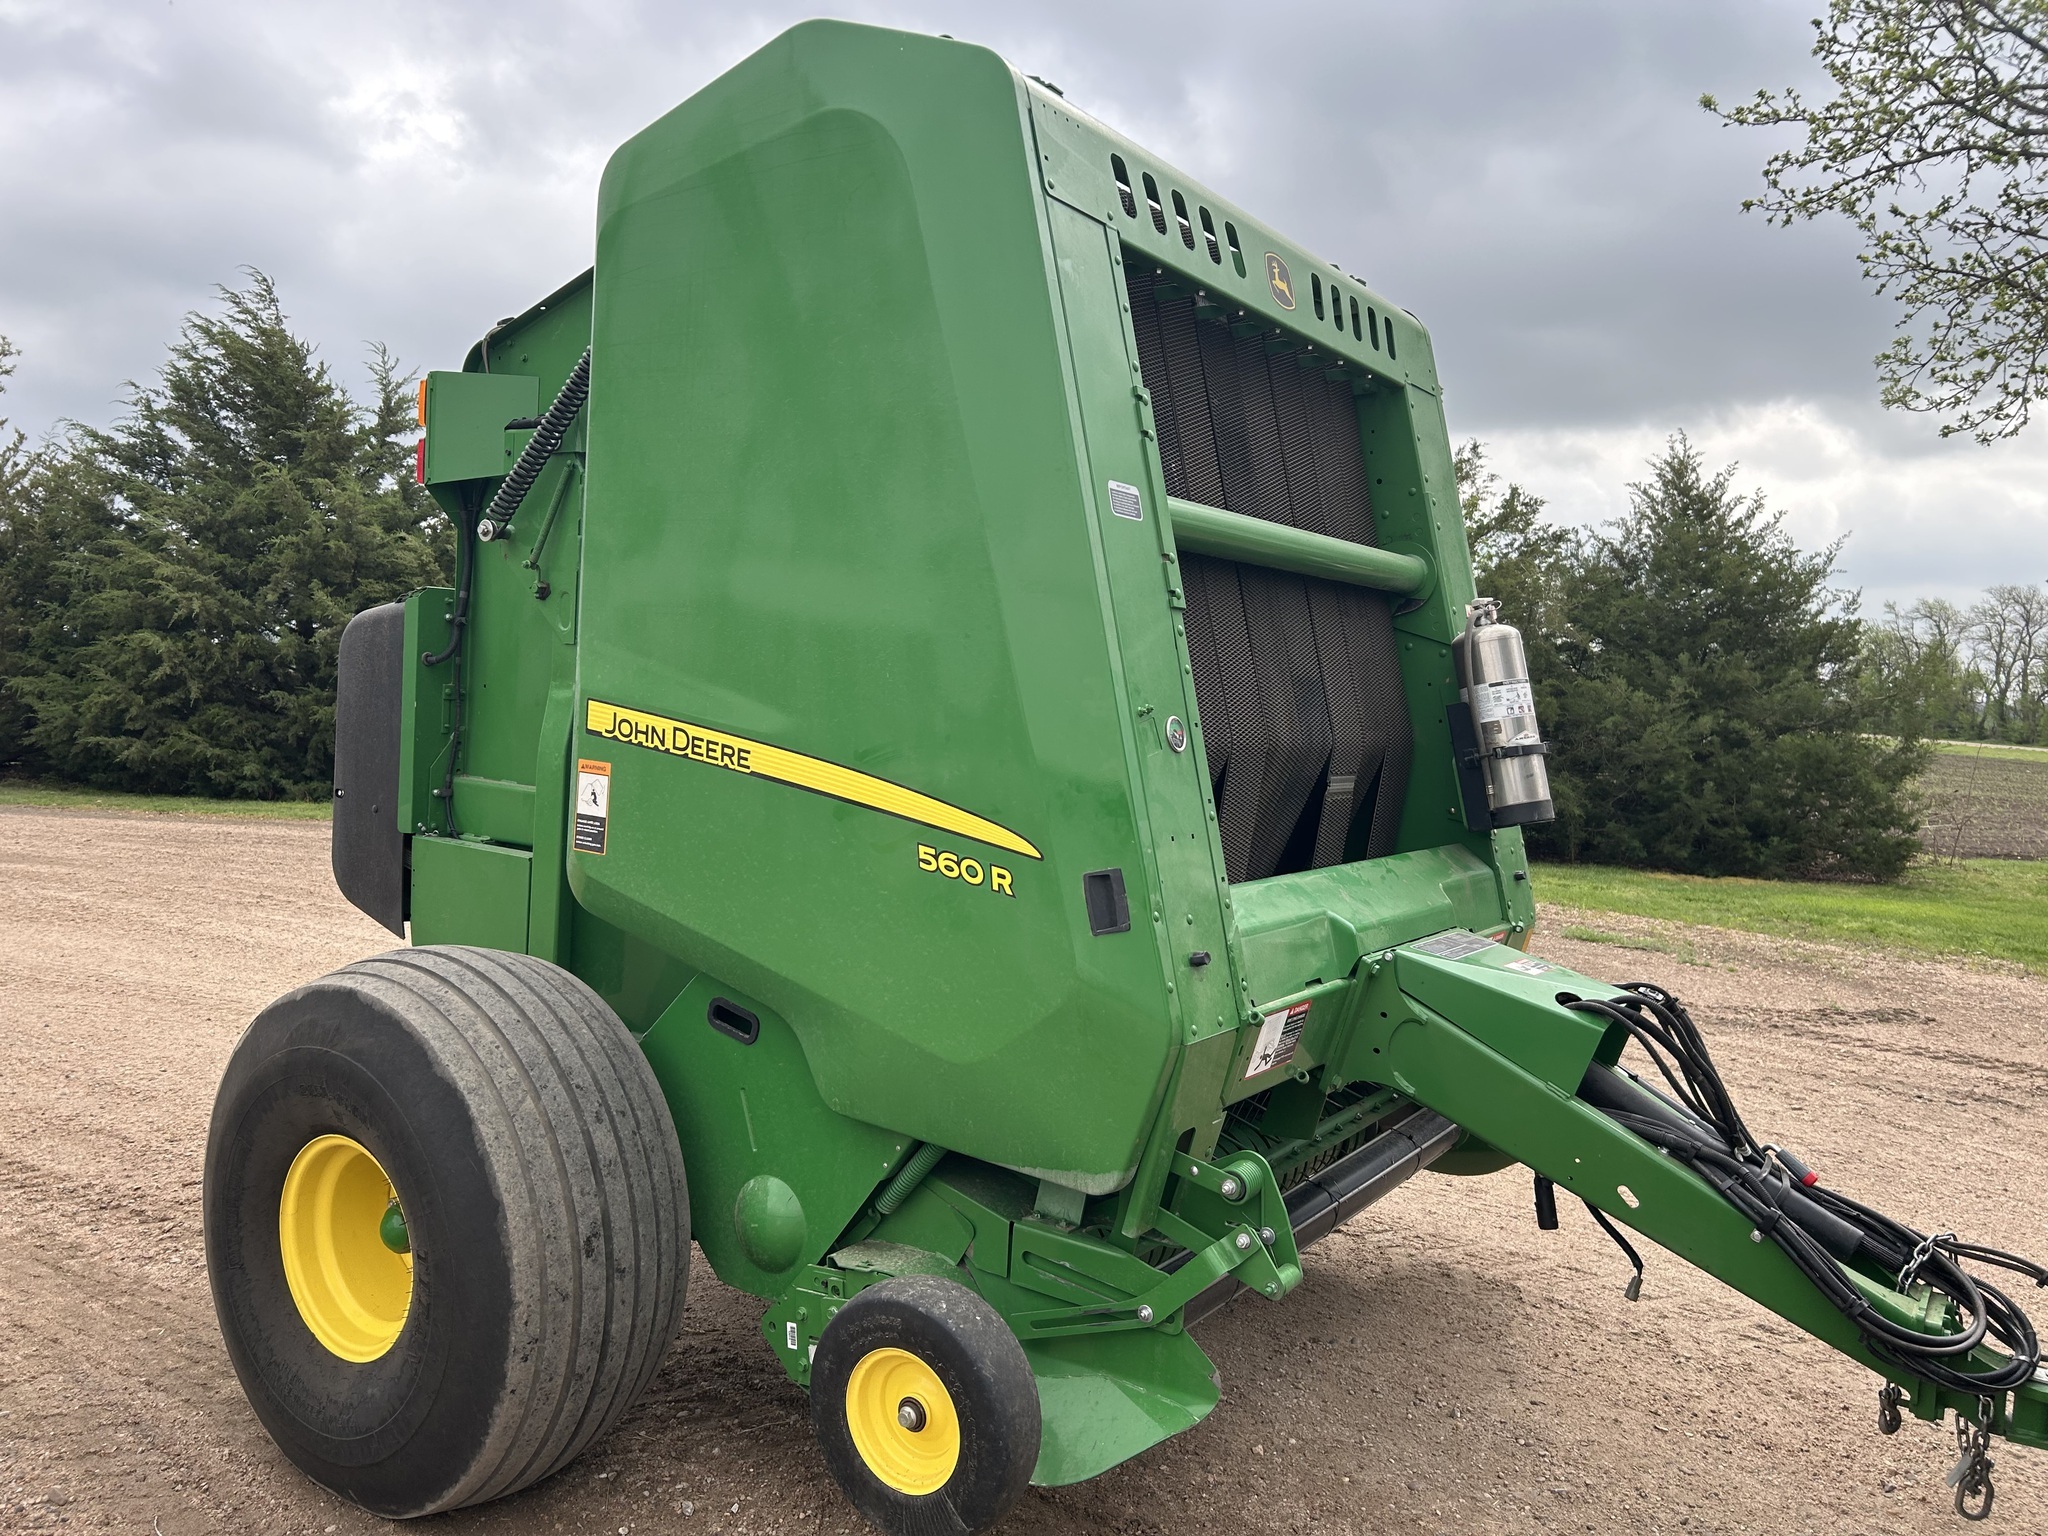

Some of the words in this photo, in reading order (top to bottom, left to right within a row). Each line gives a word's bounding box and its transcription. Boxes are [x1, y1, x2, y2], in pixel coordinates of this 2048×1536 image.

[585, 764, 607, 772] WARNING
[604, 711, 666, 748] JOHN
[672, 726, 751, 770] DEERE
[917, 842, 985, 886] 560
[990, 863, 1016, 898] R
